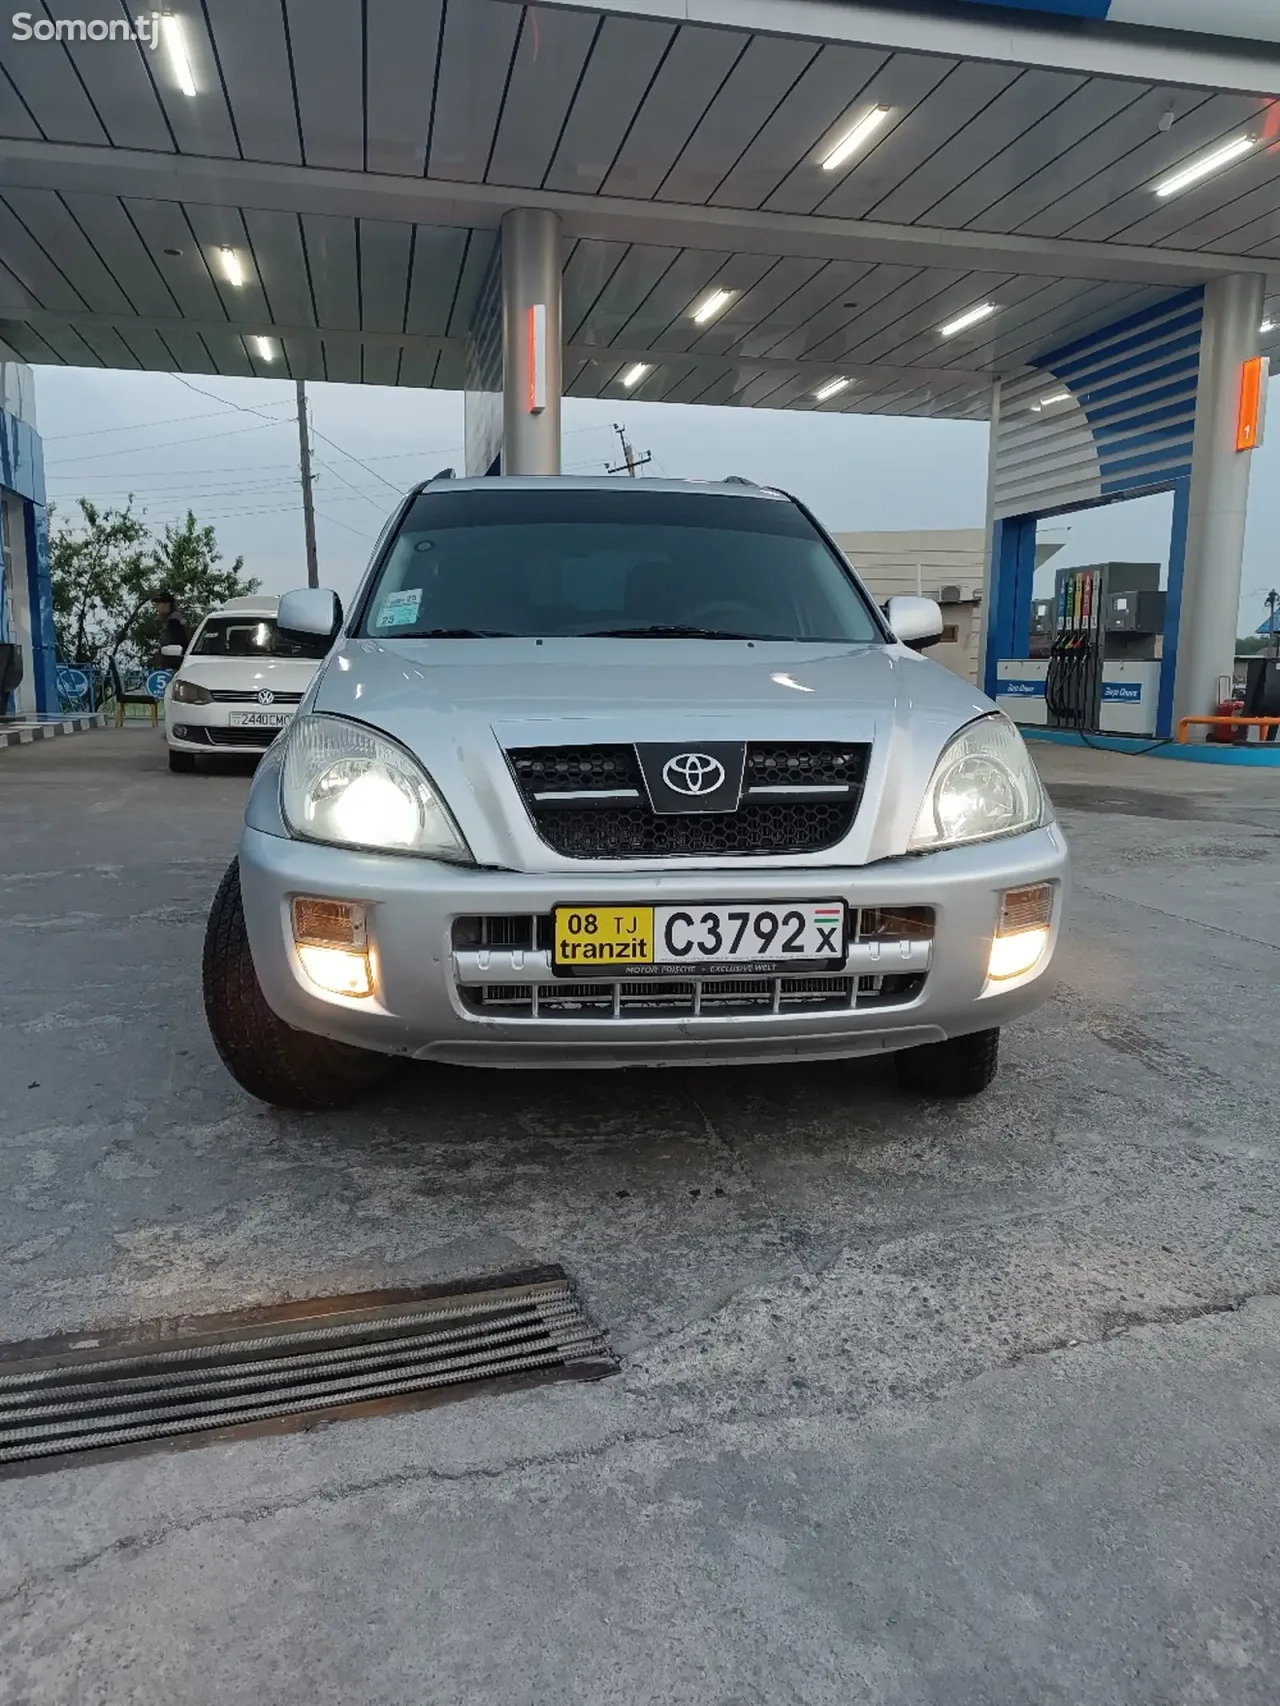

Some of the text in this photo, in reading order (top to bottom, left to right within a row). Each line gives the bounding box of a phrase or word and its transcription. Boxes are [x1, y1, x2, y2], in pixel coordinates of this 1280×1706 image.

[156, 675, 167, 689] 5
[568, 914, 637, 934] 08 TJ
[664, 910, 838, 957] C3792 X
[560, 938, 647, 959] tranzit
[625, 966, 658, 974] MOTOR
